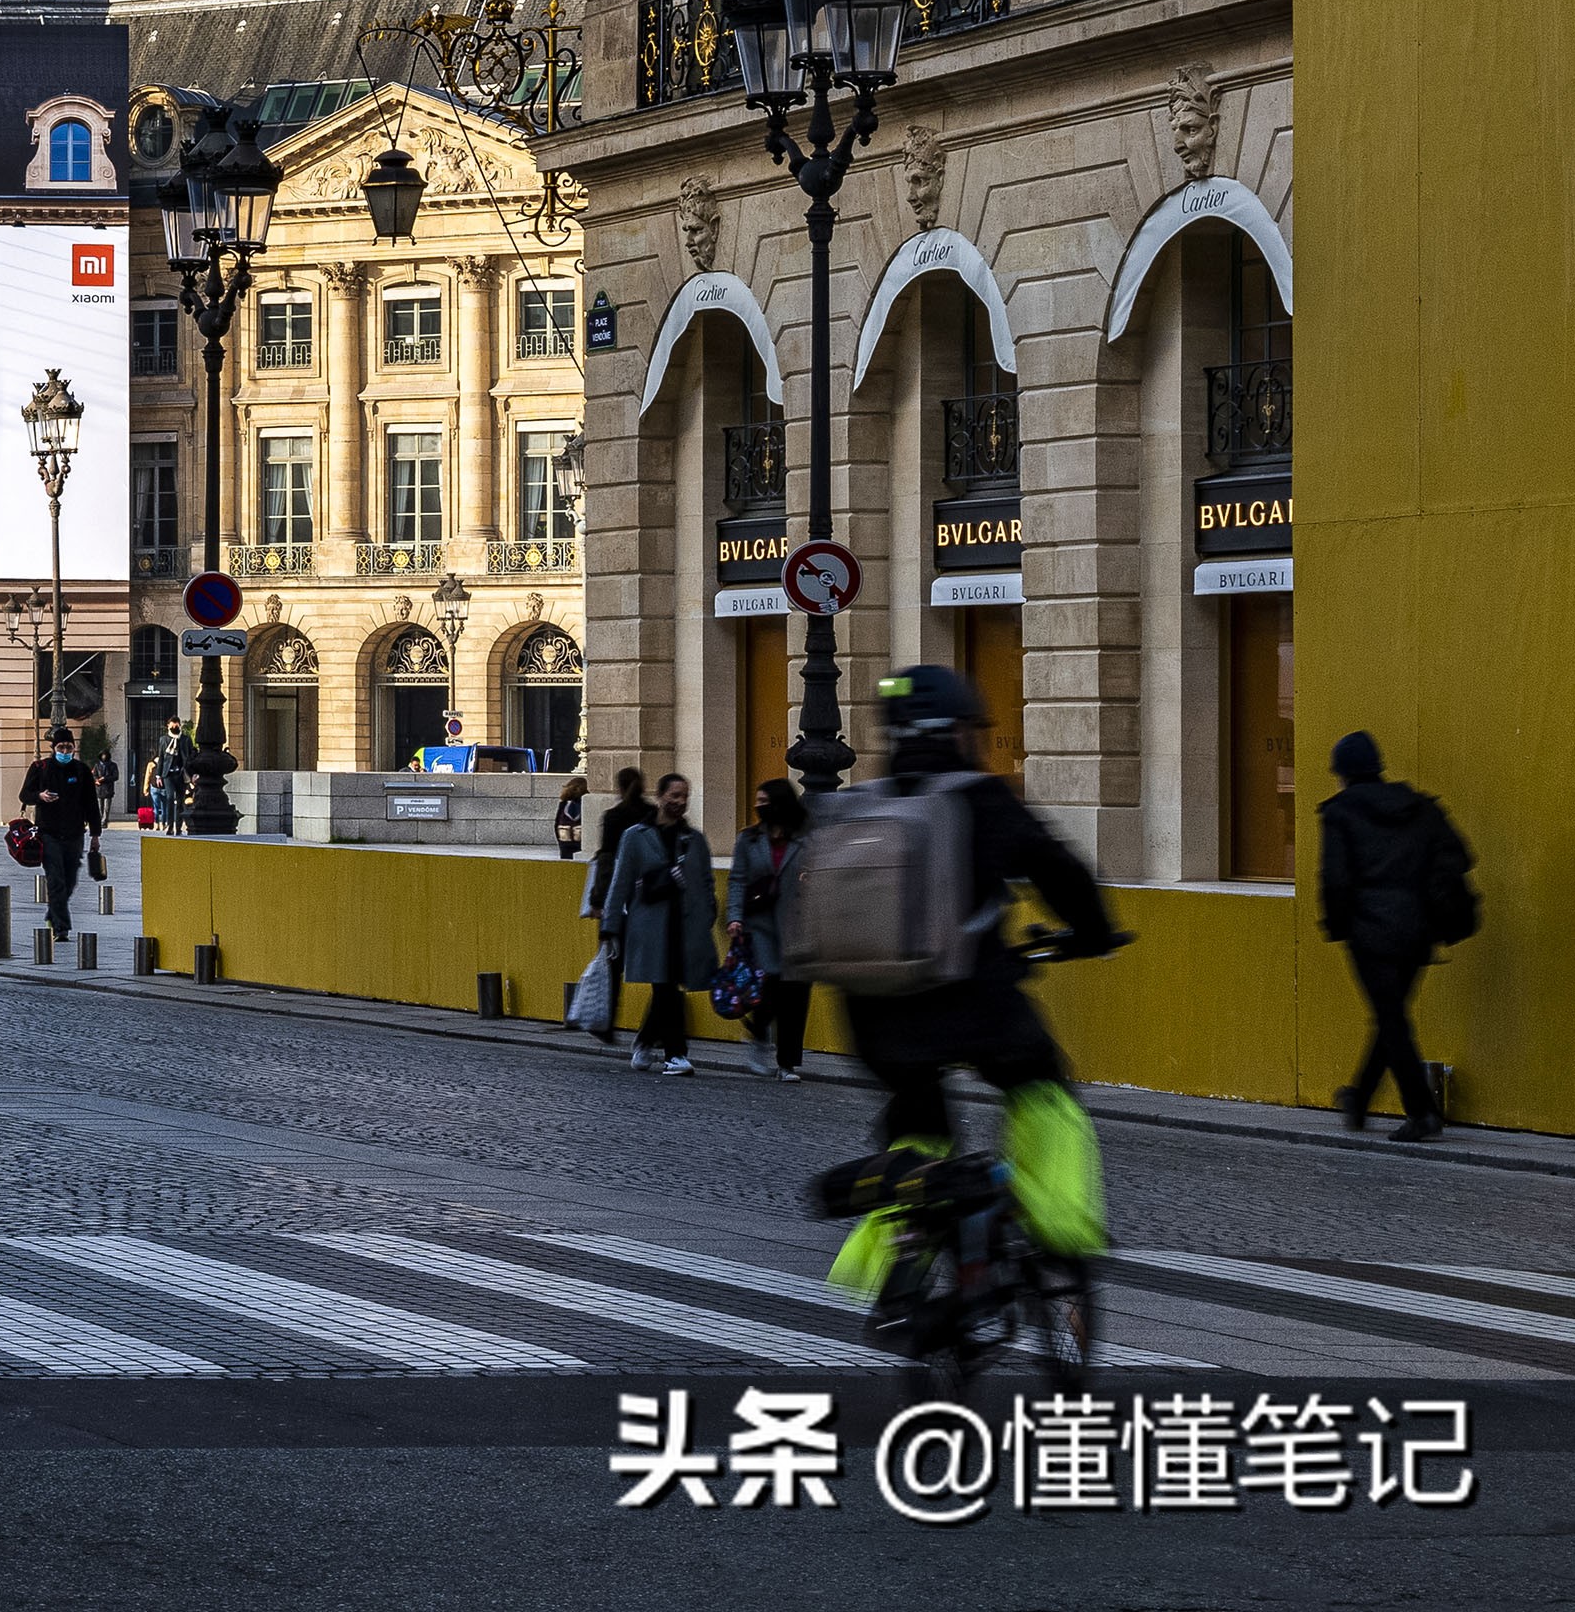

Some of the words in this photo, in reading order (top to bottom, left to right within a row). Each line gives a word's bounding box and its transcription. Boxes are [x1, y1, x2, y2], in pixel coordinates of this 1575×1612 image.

[1182, 184, 1229, 214] Cartier
[913, 240, 954, 267] Cartier
[694, 278, 728, 302] Cartier
[72, 294, 115, 303] xiaomi
[595, 317, 608, 327] PLACE
[1219, 571, 1285, 588] BVLGARI
[952, 585, 1005, 601] BVLGARI
[732, 597, 779, 612] BVLGARI
